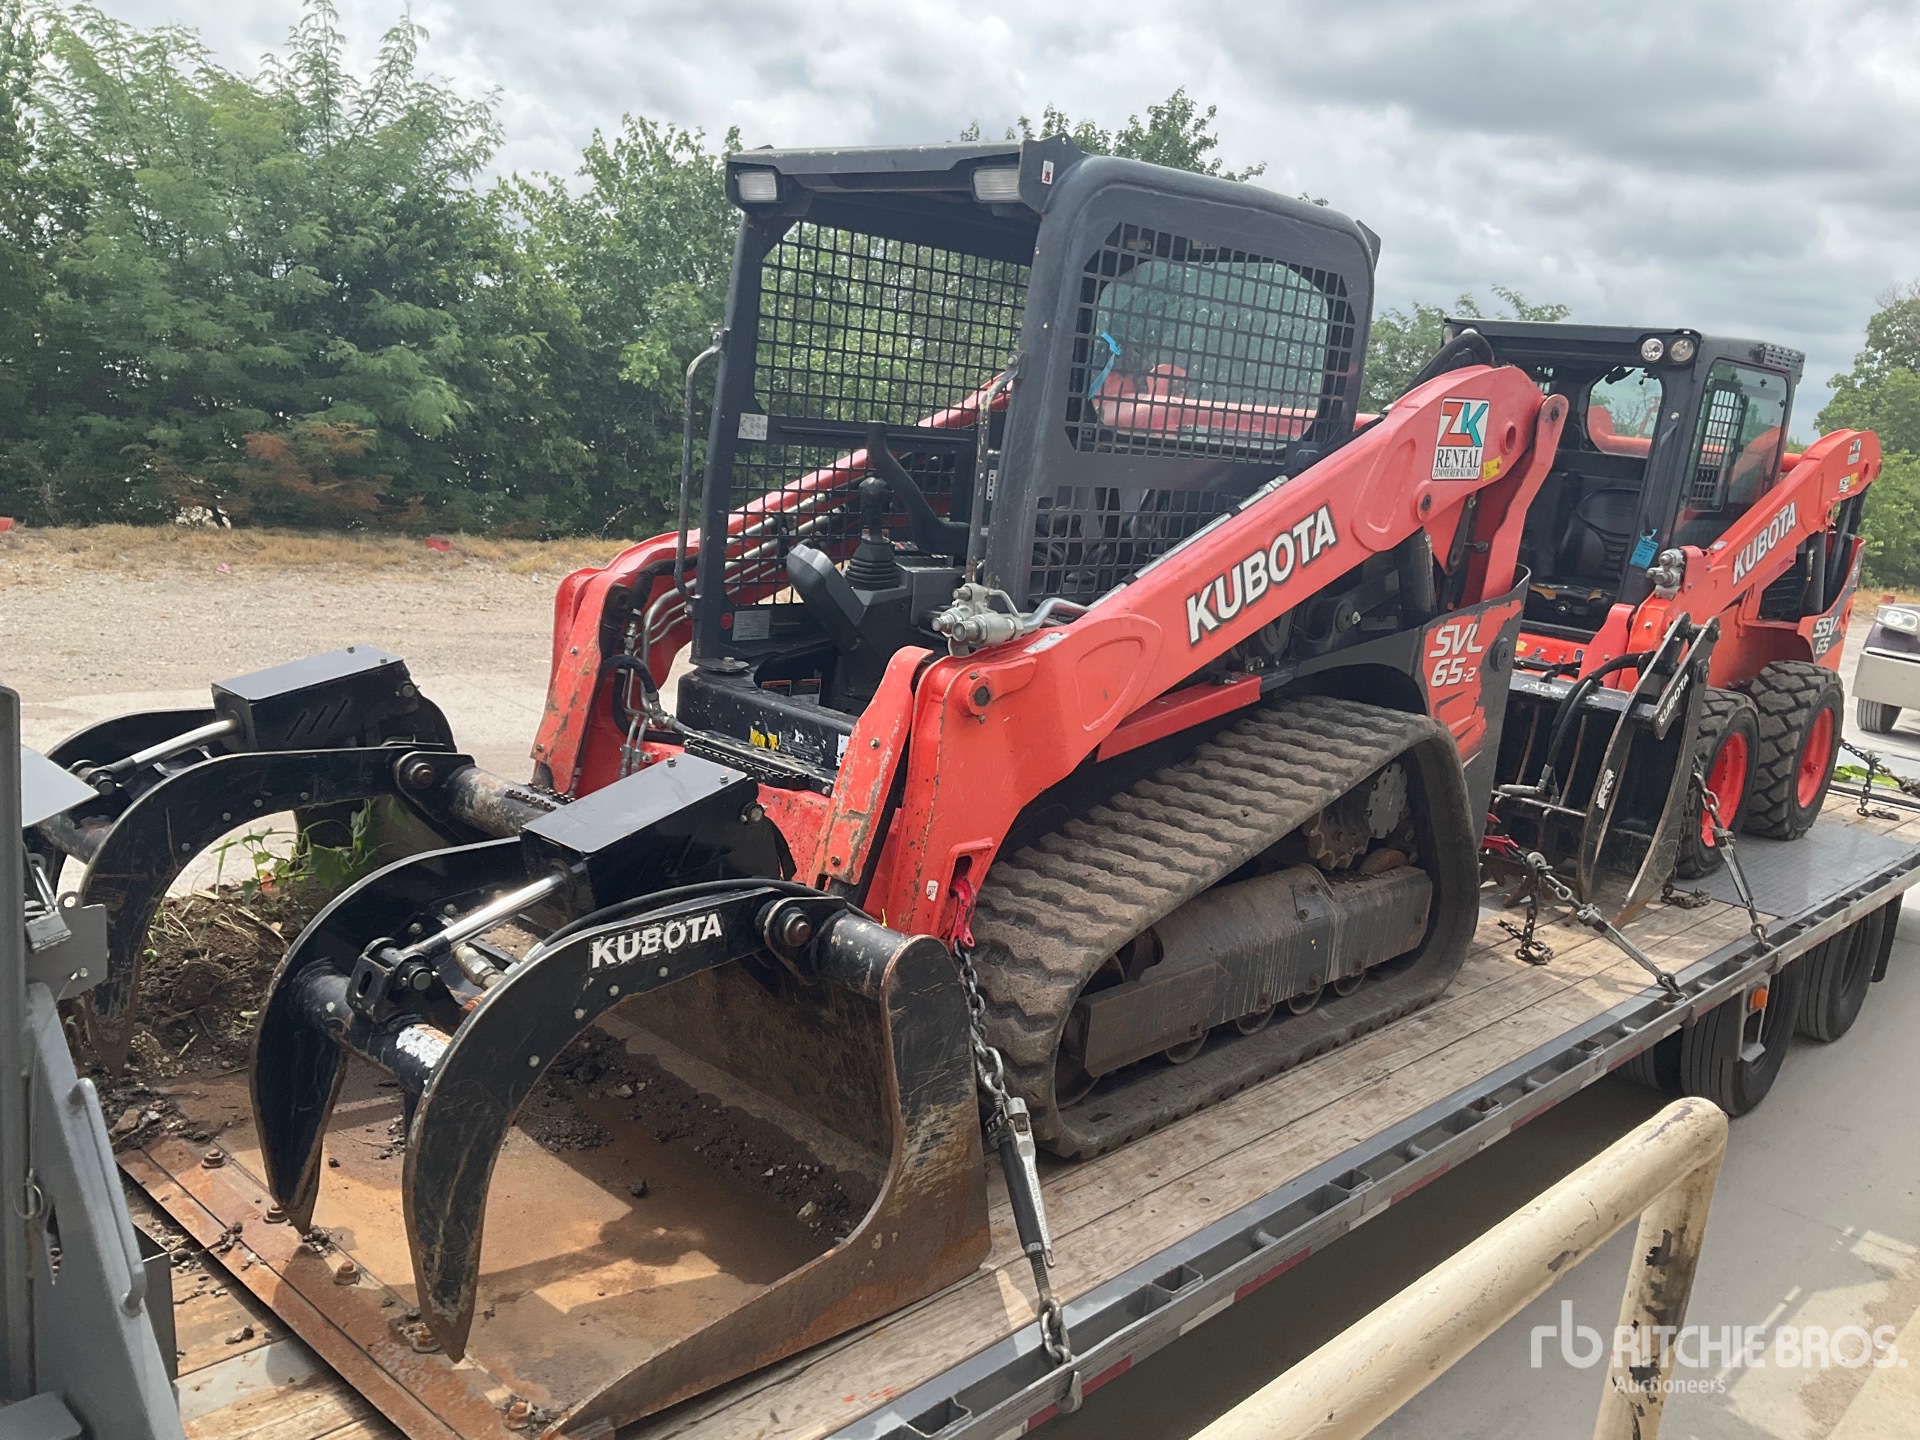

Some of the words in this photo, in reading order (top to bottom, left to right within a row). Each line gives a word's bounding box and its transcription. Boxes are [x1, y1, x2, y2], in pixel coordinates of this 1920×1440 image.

[1437, 401, 1489, 447] ZK
[1435, 449, 1480, 469] RENTAL
[1733, 501, 1797, 586] KUBOTA
[1186, 505, 1337, 644] KUBOTA
[1429, 623, 1483, 658] SVL
[1812, 615, 1840, 639] SSV
[1815, 637, 1831, 655] 65
[1430, 657, 1477, 687] 65-2
[591, 912, 723, 969] KUBOTA
